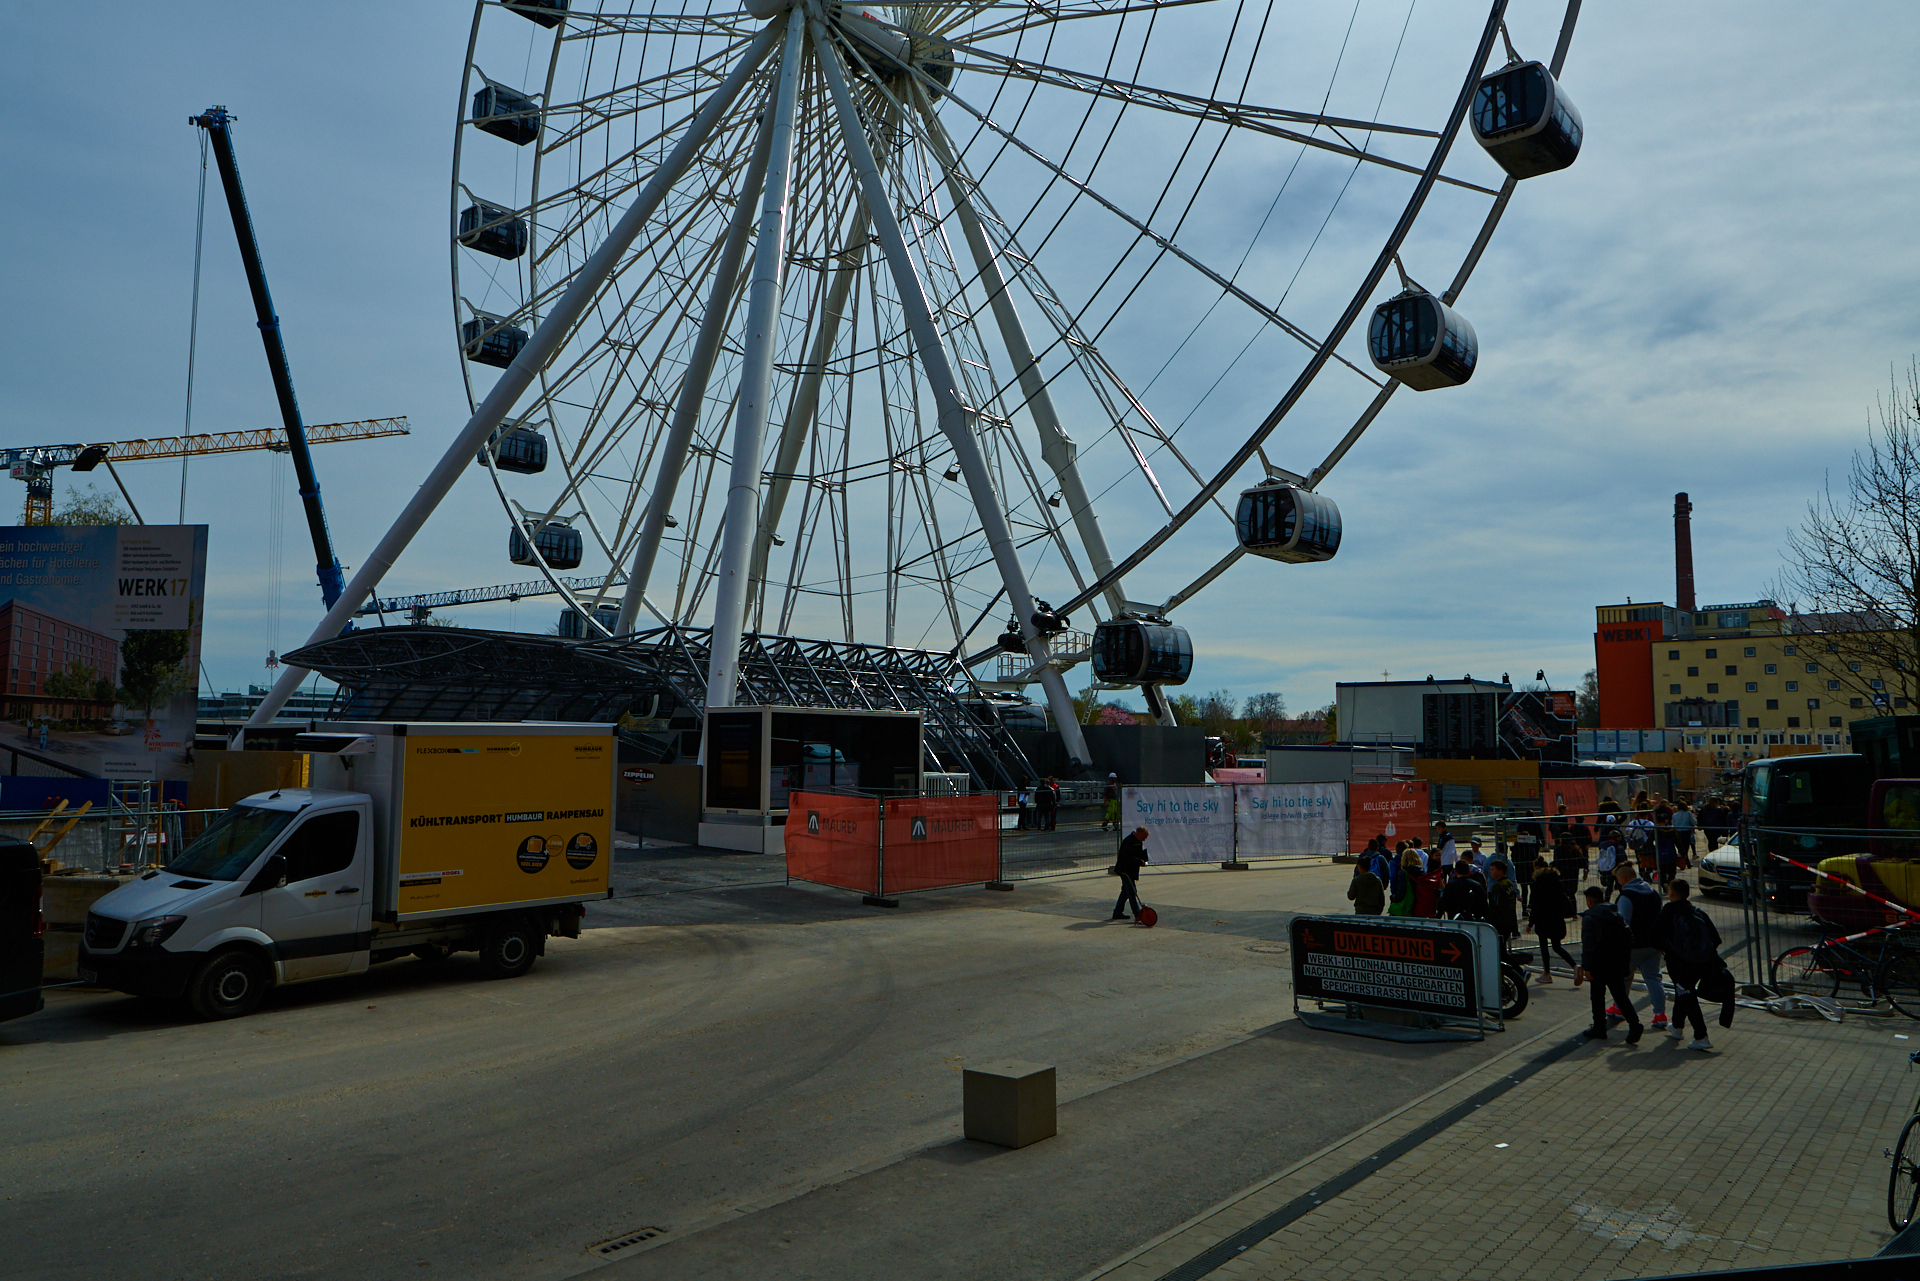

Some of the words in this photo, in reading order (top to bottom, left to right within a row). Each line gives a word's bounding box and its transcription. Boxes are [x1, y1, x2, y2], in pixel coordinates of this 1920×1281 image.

[17, 540, 84, 555] hochwertiger
[32, 556, 46, 568] für
[50, 557, 102, 570] Hotellerie,
[16, 572, 82, 585] Gastronomie.
[623, 771, 654, 779] ZEPPELIN
[1136, 799, 1154, 815] Say
[1158, 800, 1166, 812] hi
[1170, 801, 1180, 812] to
[1184, 800, 1199, 812] the
[1203, 799, 1219, 813] sky
[1252, 797, 1269, 810] Say
[1272, 796, 1281, 808] hi
[1284, 798, 1295, 808] to
[1298, 796, 1313, 807] the
[1316, 795, 1332, 808] sky
[1364, 801, 1389, 811] KOLLEGE
[1391, 800, 1416, 810] GESUCHT
[410, 814, 502, 828] KÜHLTRANSPORT
[506, 813, 543, 822] HUMBAUR
[546, 809, 604, 820] RAMPENSAU
[1144, 817, 1164, 826] Kollege
[1188, 816, 1210, 825] gesucht
[1303, 811, 1323, 820] gesucht
[823, 818, 858, 834] MAURER
[931, 819, 974, 834] MAURER
[1336, 934, 1432, 958] UMLEITUNG
[1309, 954, 1351, 967] WERK1-10
[1355, 959, 1401, 973] TONHALLE
[1405, 964, 1462, 980] TECHNIKUM
[1304, 966, 1372, 981] NACHTKANTINE
[1376, 973, 1462, 993] SCHLAGERGARTEN
[1323, 980, 1406, 999] SPEICHERSTRASSE
[1410, 991, 1464, 1006] WILLENLOS
